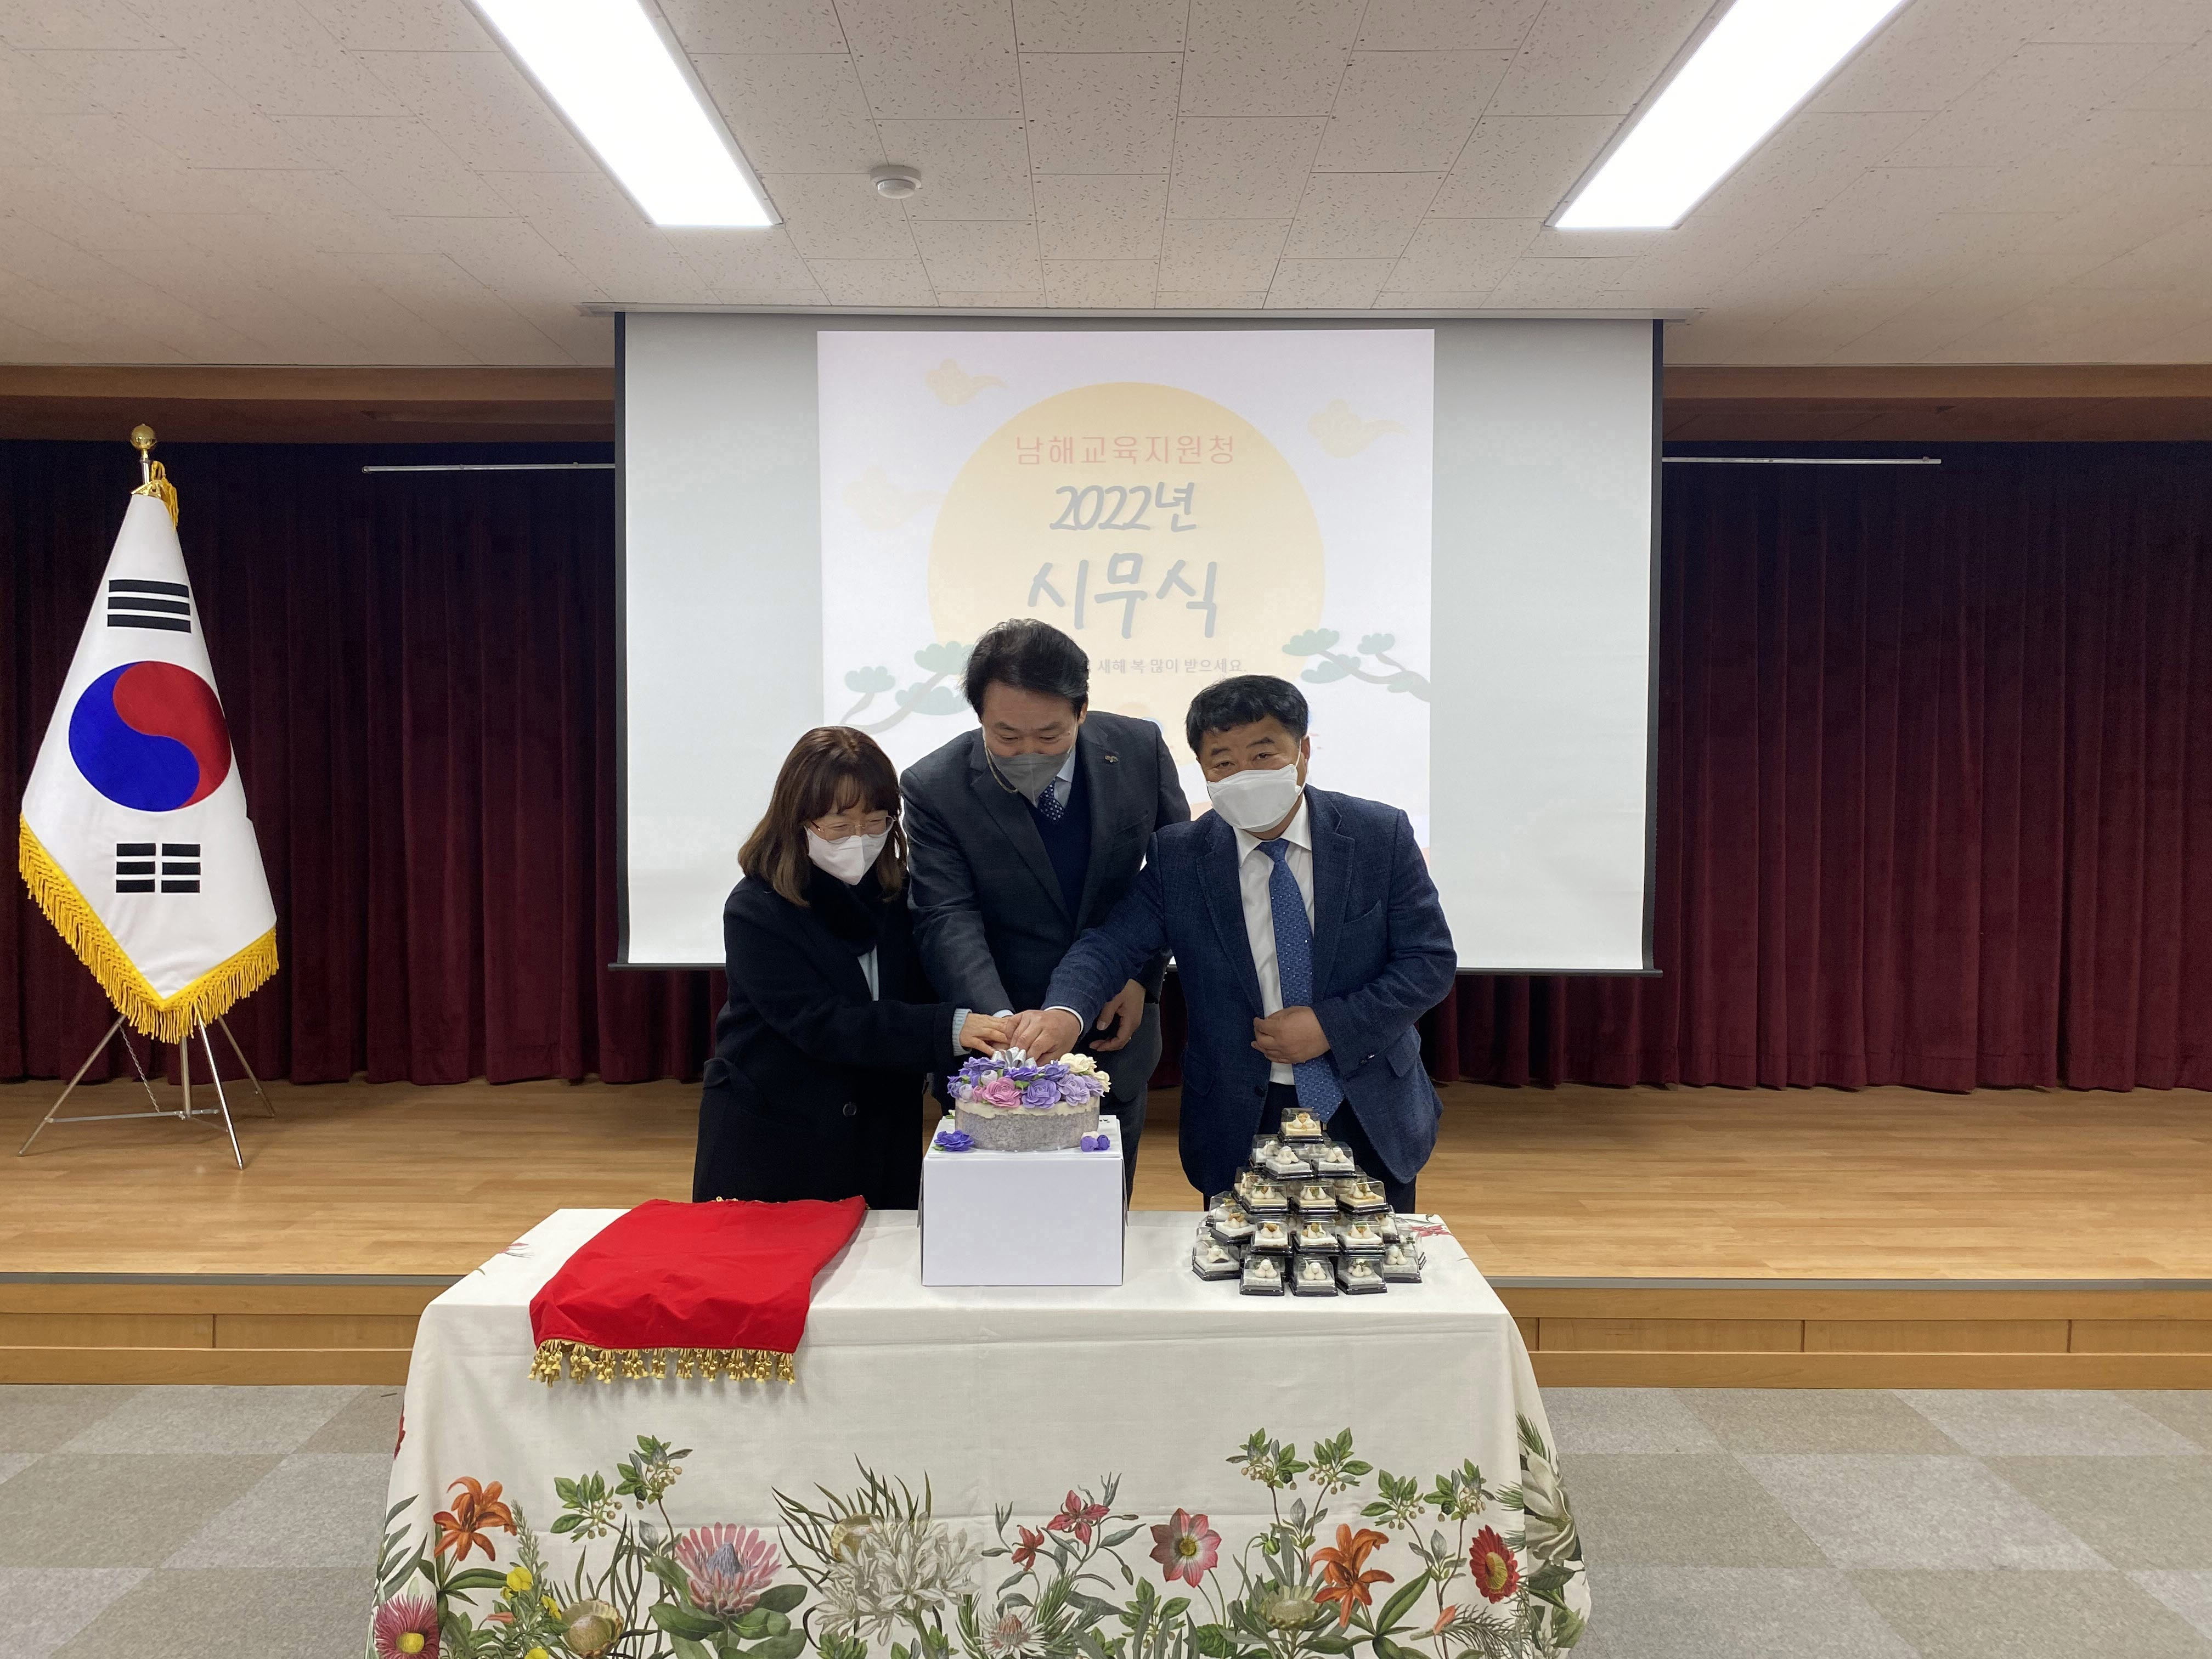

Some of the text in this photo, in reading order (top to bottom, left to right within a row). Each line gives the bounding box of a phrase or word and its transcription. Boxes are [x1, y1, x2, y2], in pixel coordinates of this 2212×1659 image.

[1016, 435, 1234, 465] 남해교육지원청
[1049, 481, 1197, 533] 2022년
[1027, 552, 1217, 640] 시무식
[1097, 658, 1247, 674] 새해 복 많이 받으세요.
